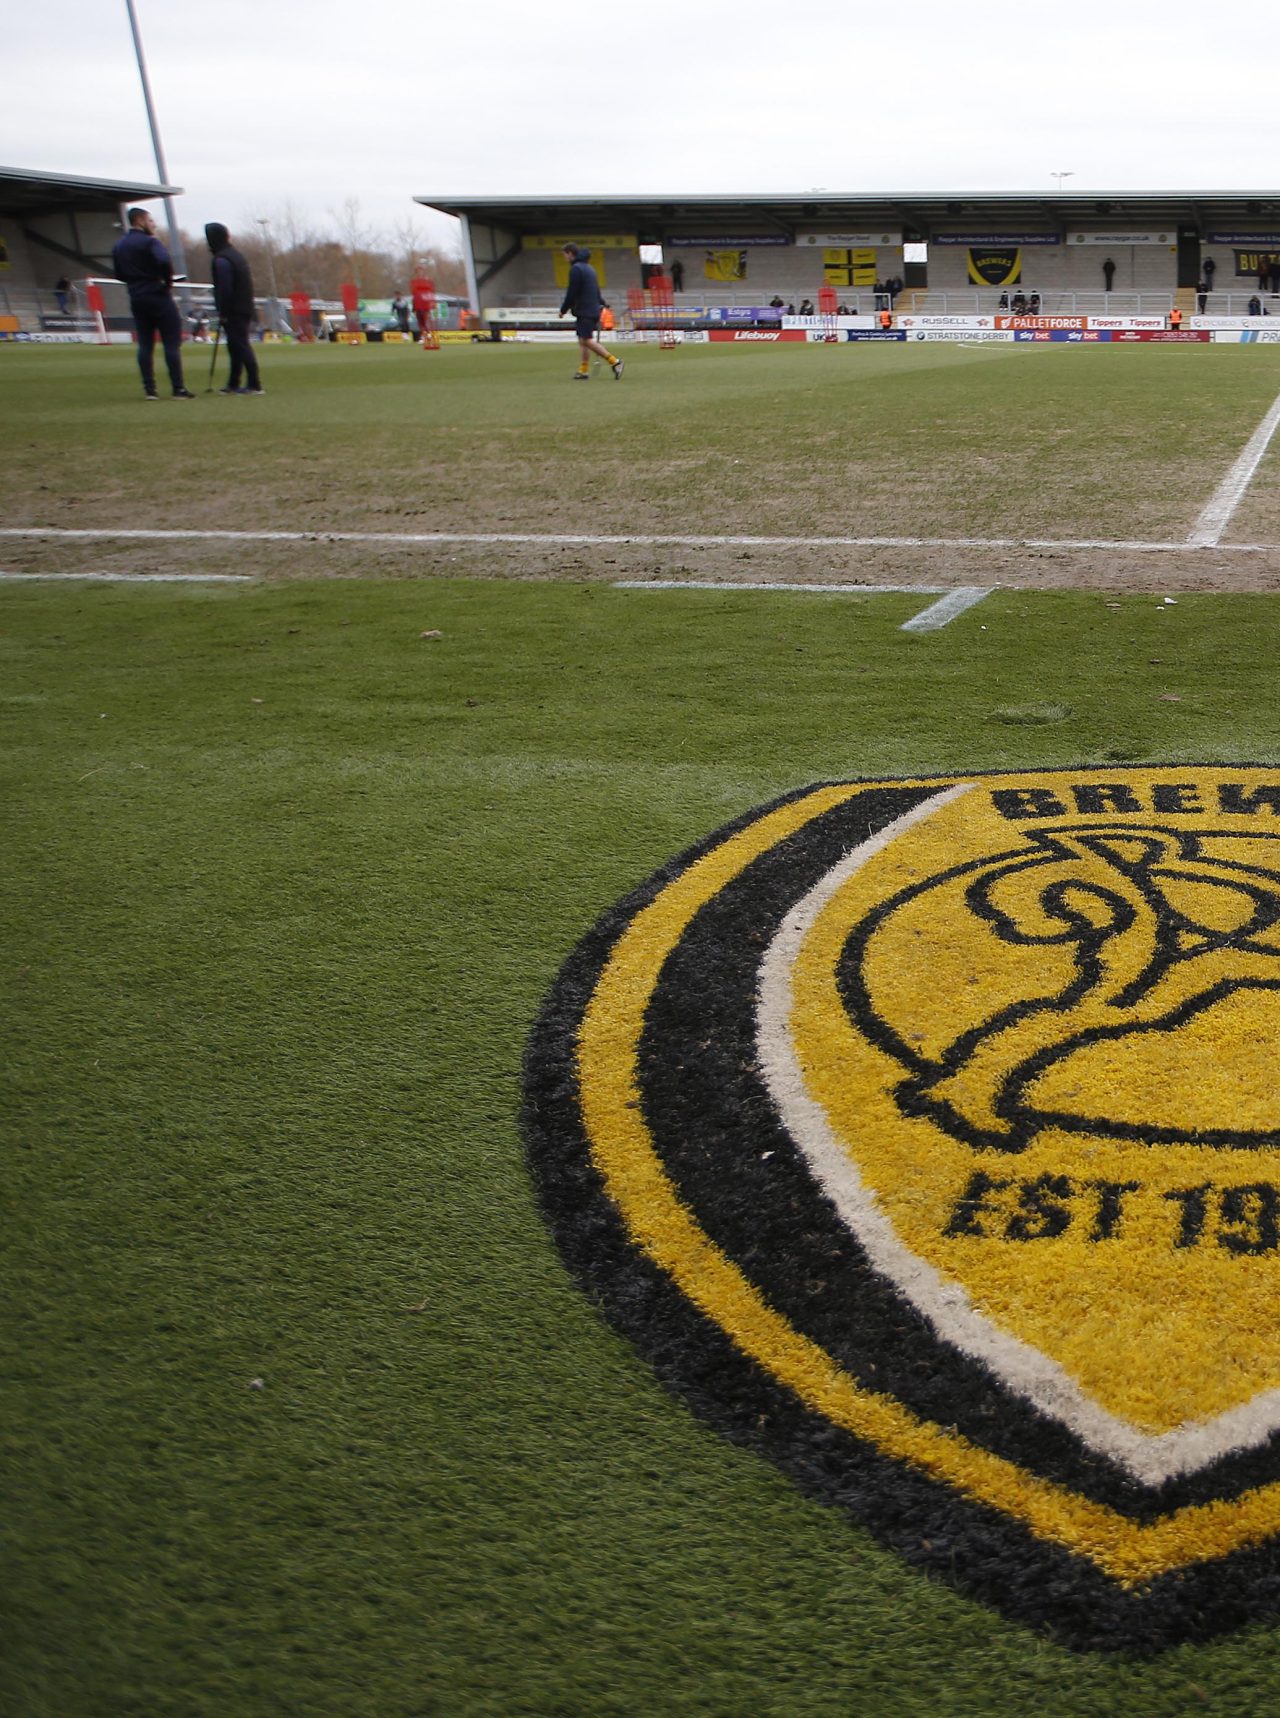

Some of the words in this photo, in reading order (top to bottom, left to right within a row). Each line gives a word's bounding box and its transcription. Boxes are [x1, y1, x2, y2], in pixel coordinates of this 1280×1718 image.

[922, 317, 969, 325] RUSSELL
[1013, 318, 1083, 329] PALLETFORCE
[1092, 318, 1123, 328] Tippers
[1130, 318, 1162, 328] Tippers
[734, 331, 780, 341] Lifebuoy
[927, 331, 980, 340] STRATSTONE
[983, 331, 1009, 340] DERBY
[1020, 332, 1034, 342] sky
[1035, 331, 1050, 340] bet
[1067, 332, 1082, 341] sky
[1083, 331, 1099, 340] bet
[941, 1170, 1139, 1242] EST
